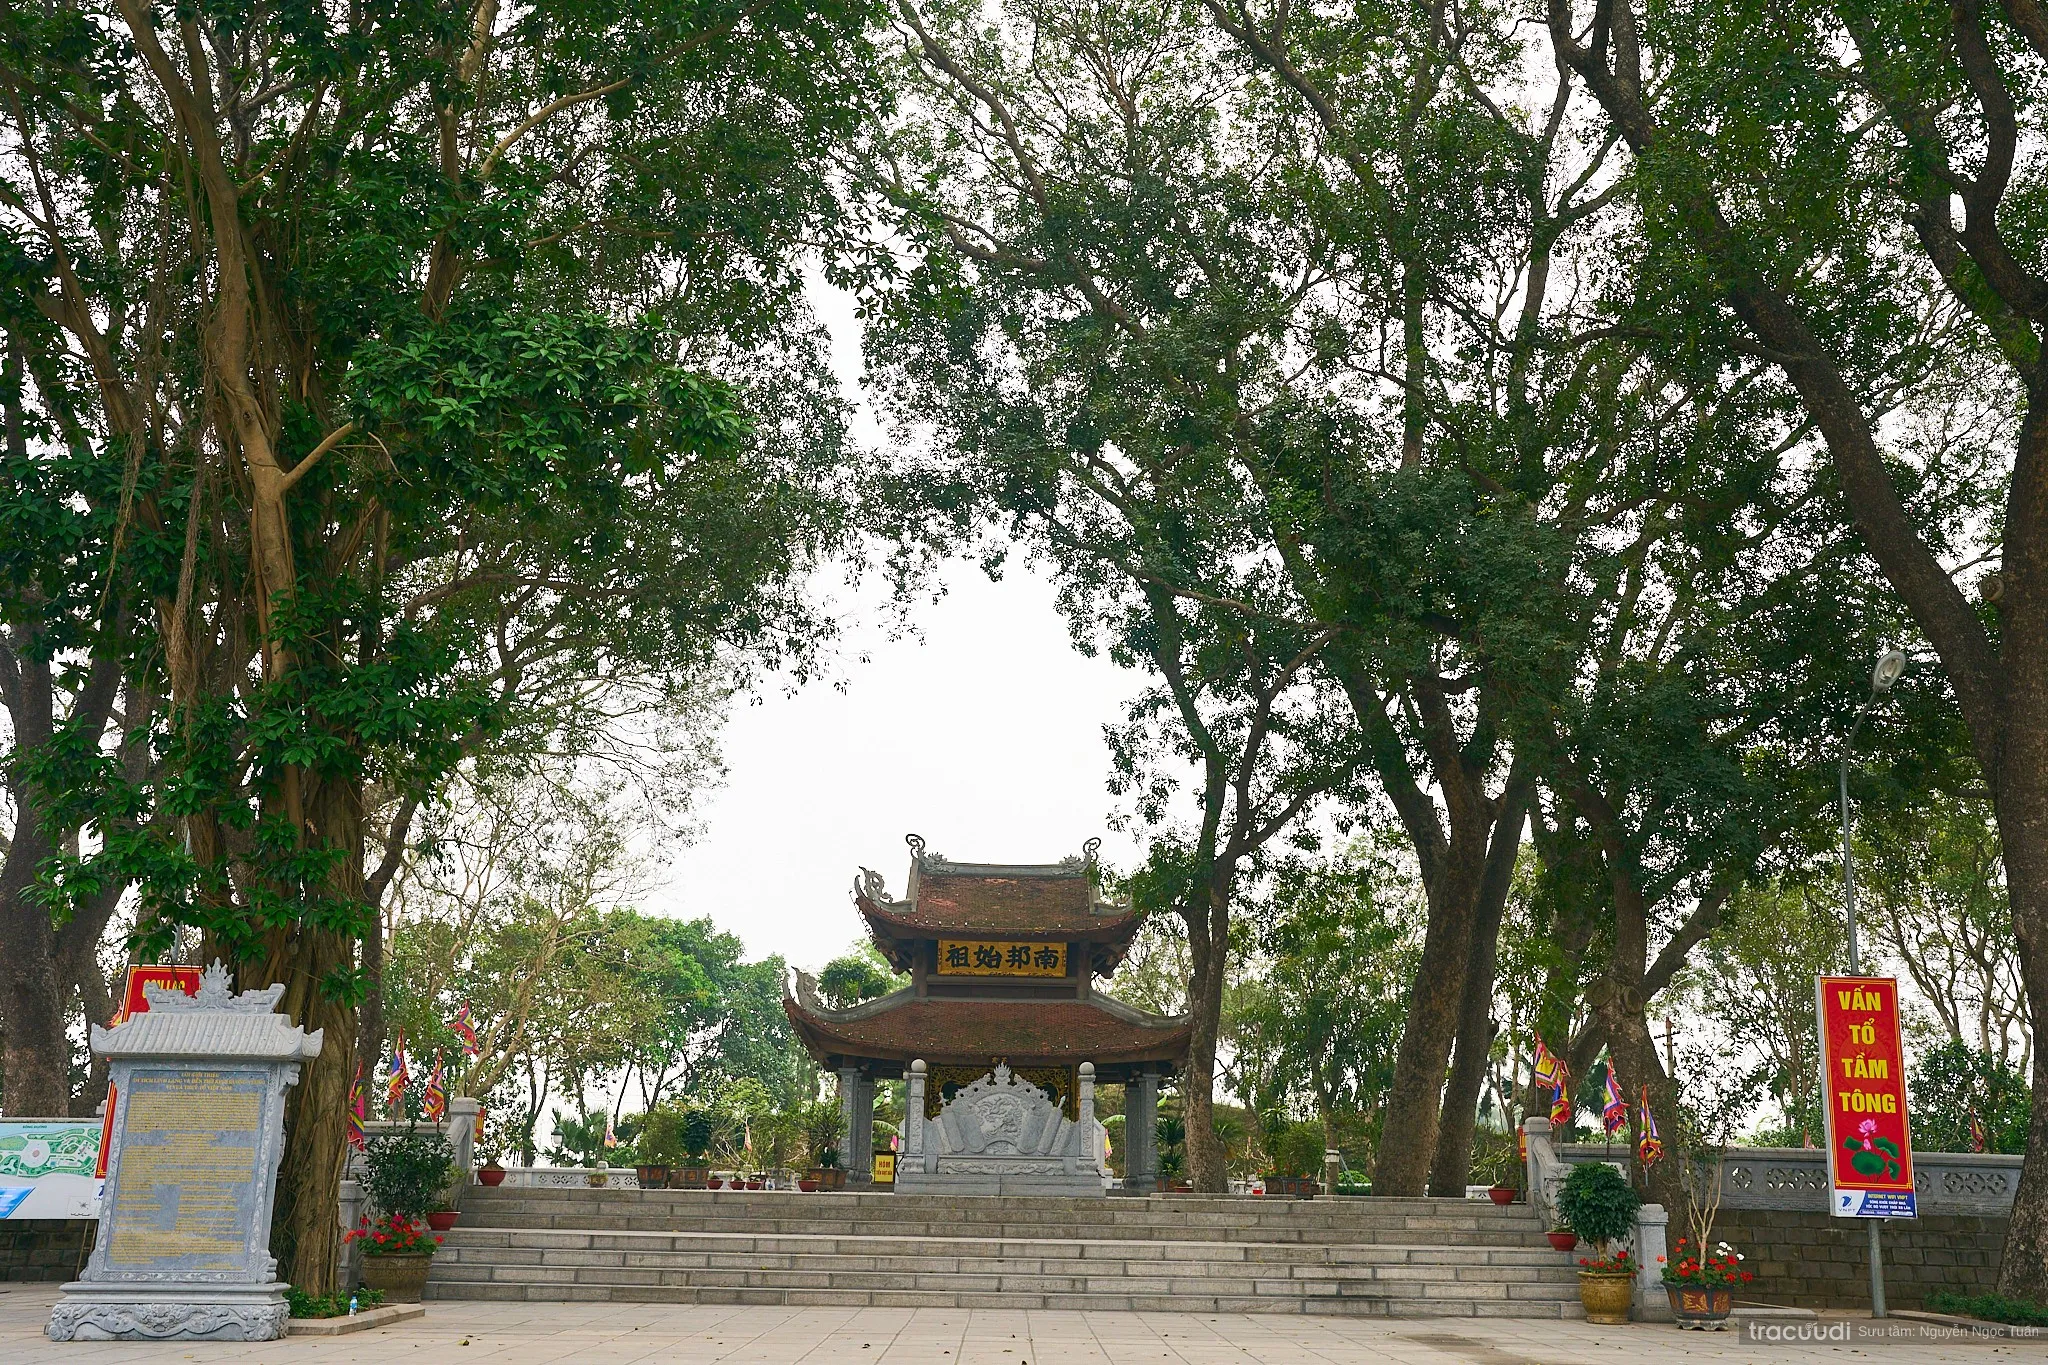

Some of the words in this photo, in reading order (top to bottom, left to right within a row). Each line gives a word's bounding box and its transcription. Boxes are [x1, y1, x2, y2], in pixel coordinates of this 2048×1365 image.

[1838, 984, 1881, 1012] VẤN
[1848, 1018, 1875, 1045] TỔ
[1841, 1052, 1888, 1079] TẦM
[1838, 1089, 1897, 1114] TÔNG
